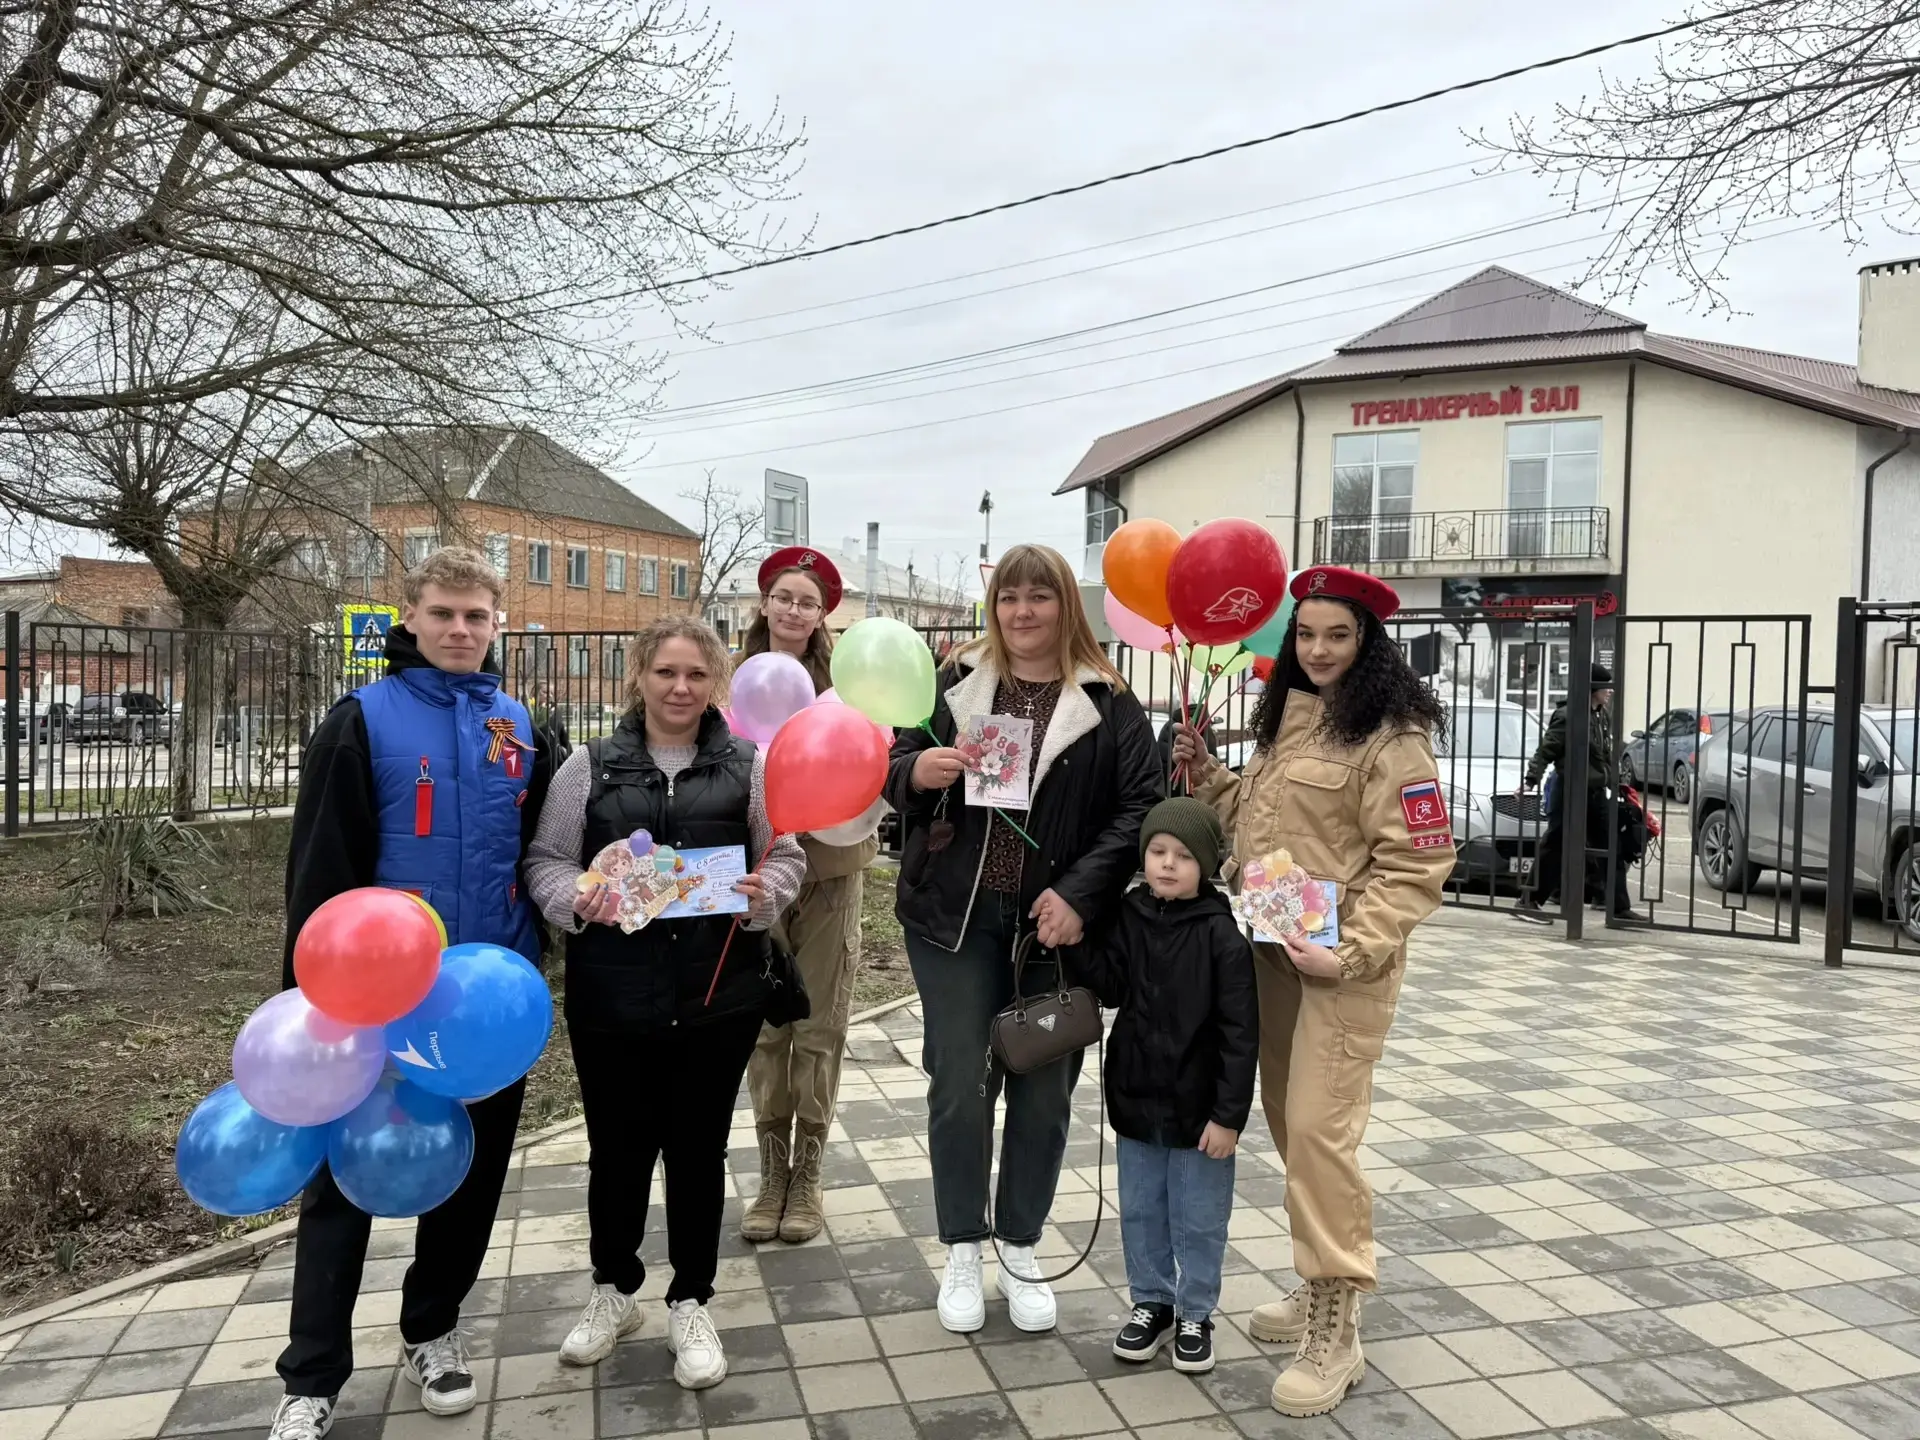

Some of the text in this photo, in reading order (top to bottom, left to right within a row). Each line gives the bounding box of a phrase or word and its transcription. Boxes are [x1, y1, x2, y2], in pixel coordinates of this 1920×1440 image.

[1351, 385, 1580, 426] ТРЕНАЖЕРНЫЙ ЗАЛ
[429, 1031, 447, 1070] Первые
